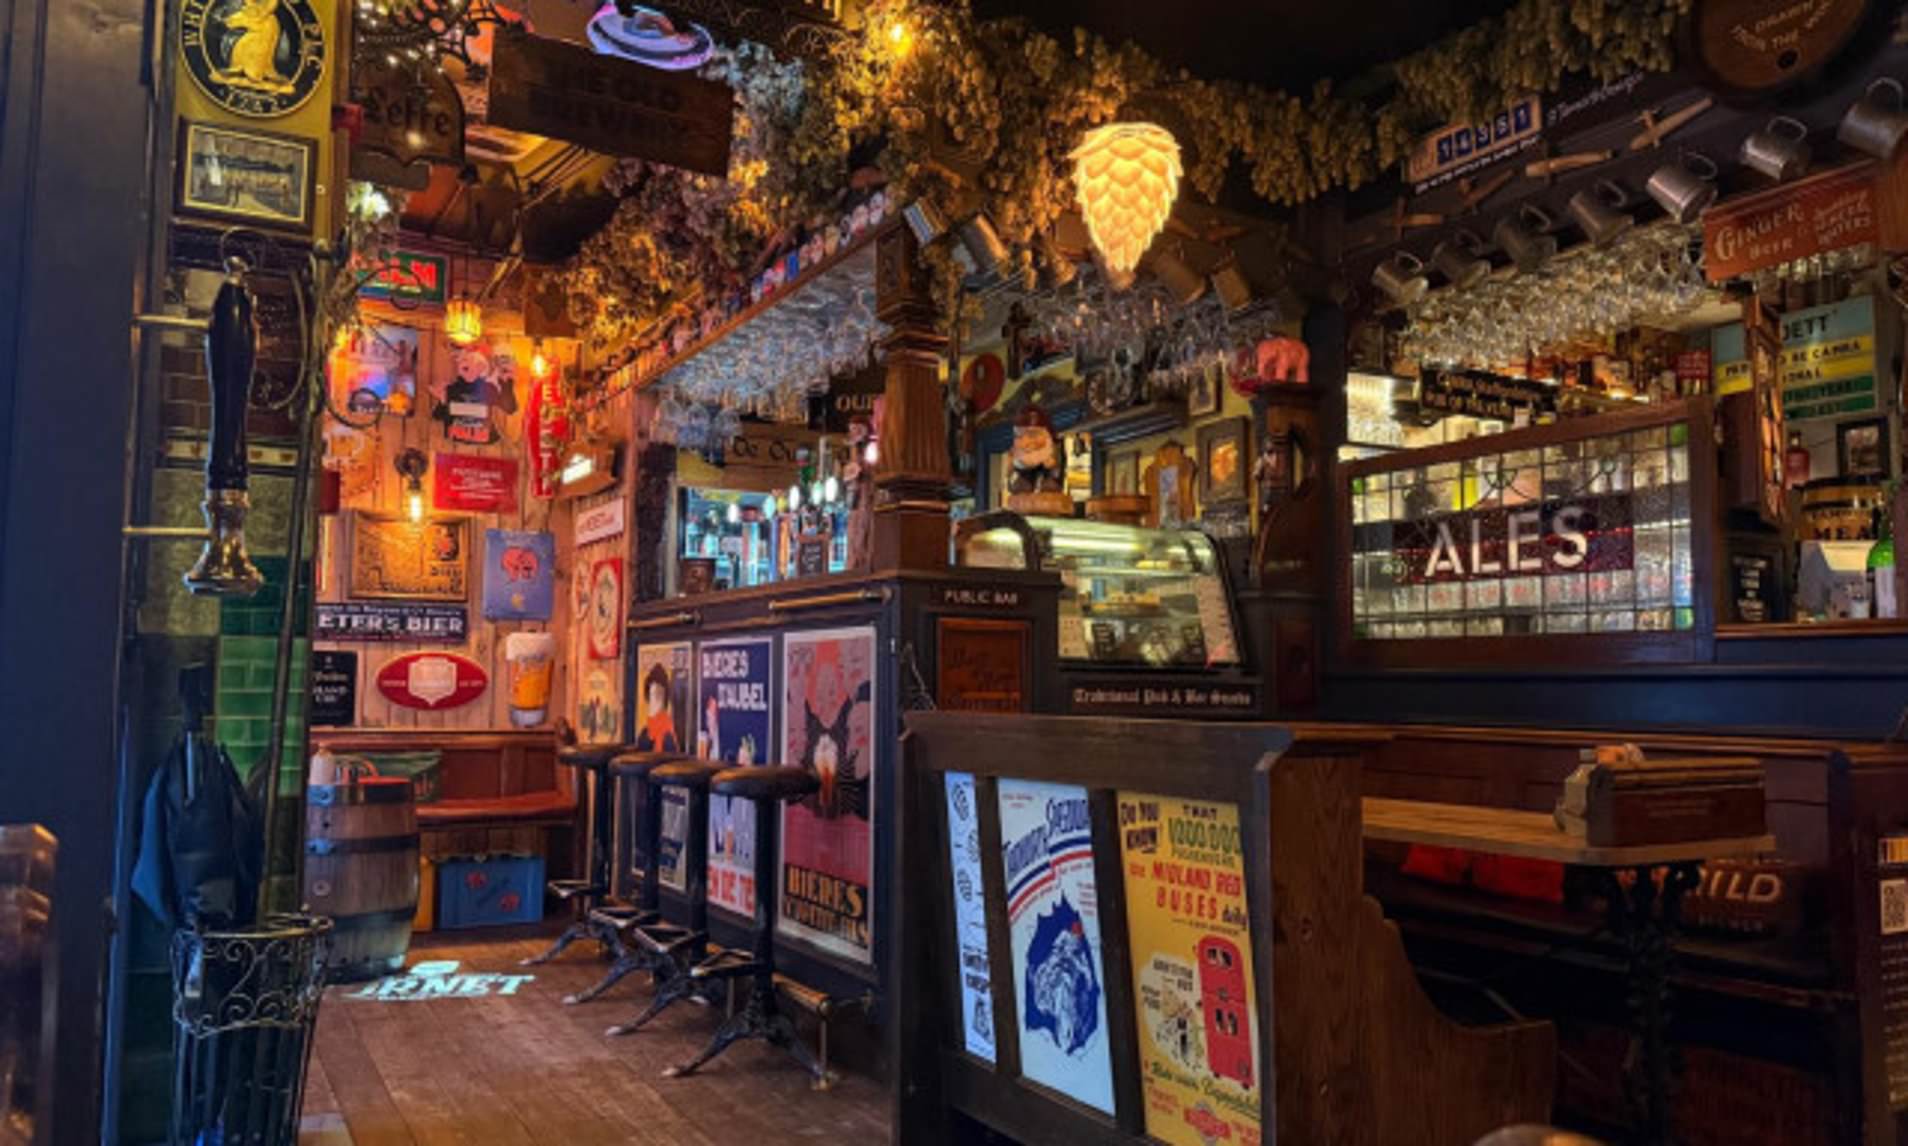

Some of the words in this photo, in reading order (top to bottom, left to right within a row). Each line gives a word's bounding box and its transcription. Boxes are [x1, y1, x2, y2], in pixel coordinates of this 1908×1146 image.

[1714, 201, 1805, 261] GINGER
[1424, 507, 1588, 577] ALES
[1813, 527, 1874, 540] MEA
[944, 589, 989, 605] PUBLIC
[994, 592, 1019, 606] BAR
[406, 616, 464, 632] BIER
[1153, 860, 1211, 890] MIDLAND
[1215, 871, 1241, 896] RED
[1156, 885, 1217, 921] BUSES
